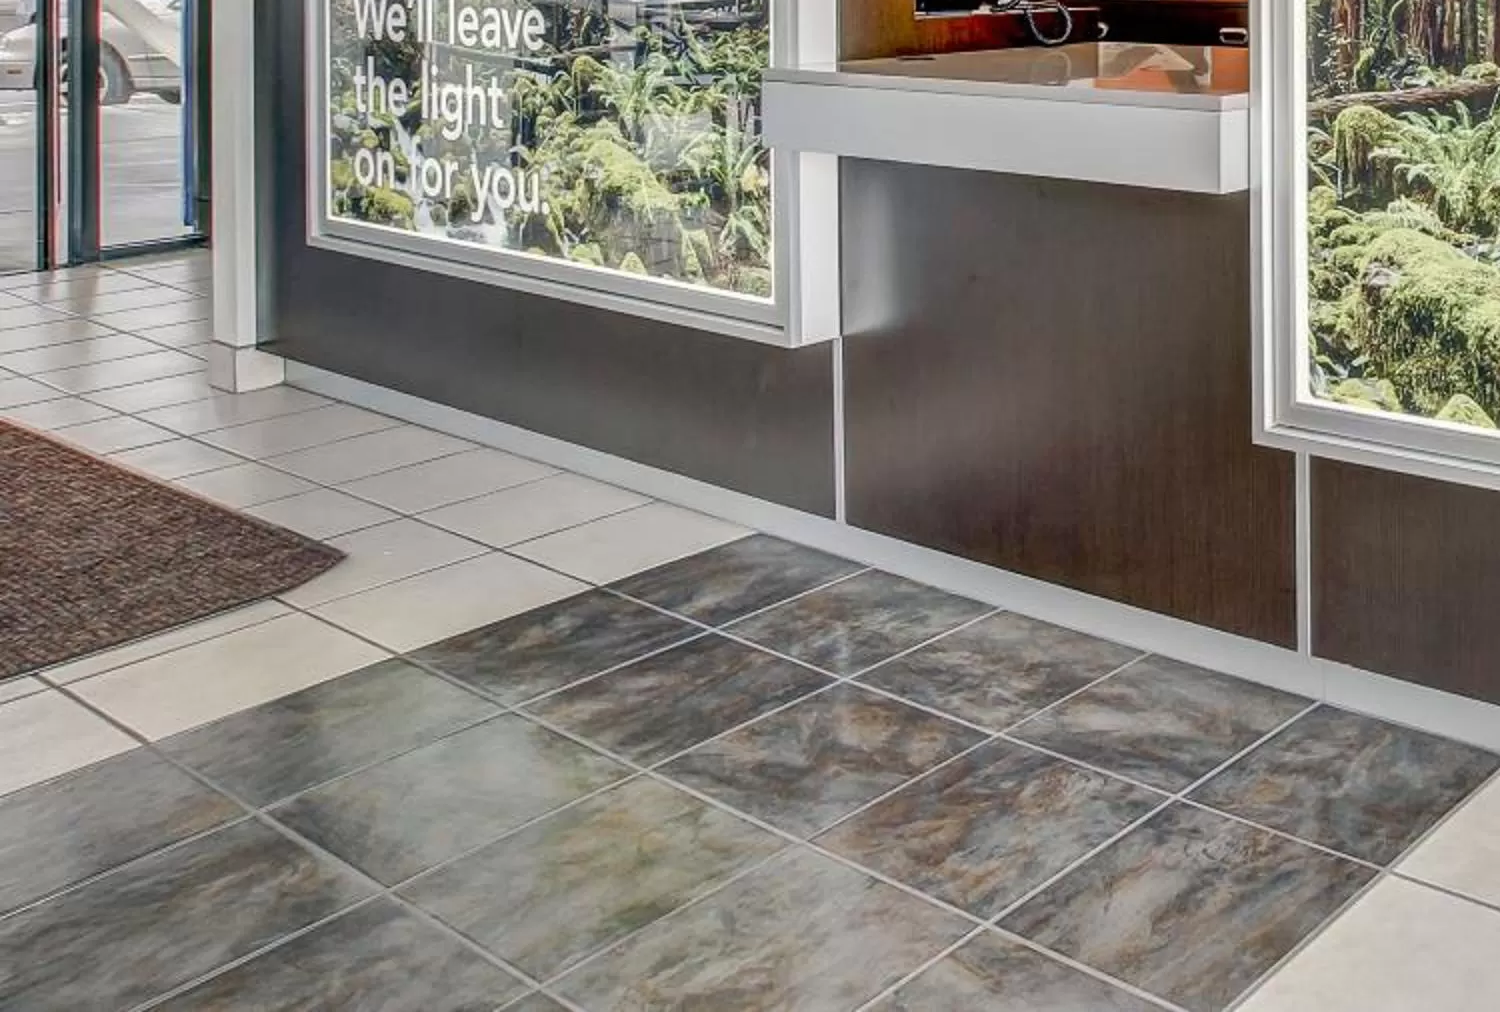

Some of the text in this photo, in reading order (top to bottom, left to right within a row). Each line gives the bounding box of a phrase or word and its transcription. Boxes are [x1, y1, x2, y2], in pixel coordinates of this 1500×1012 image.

[354, 55, 505, 142] the light
[354, 134, 551, 224] on for you.
